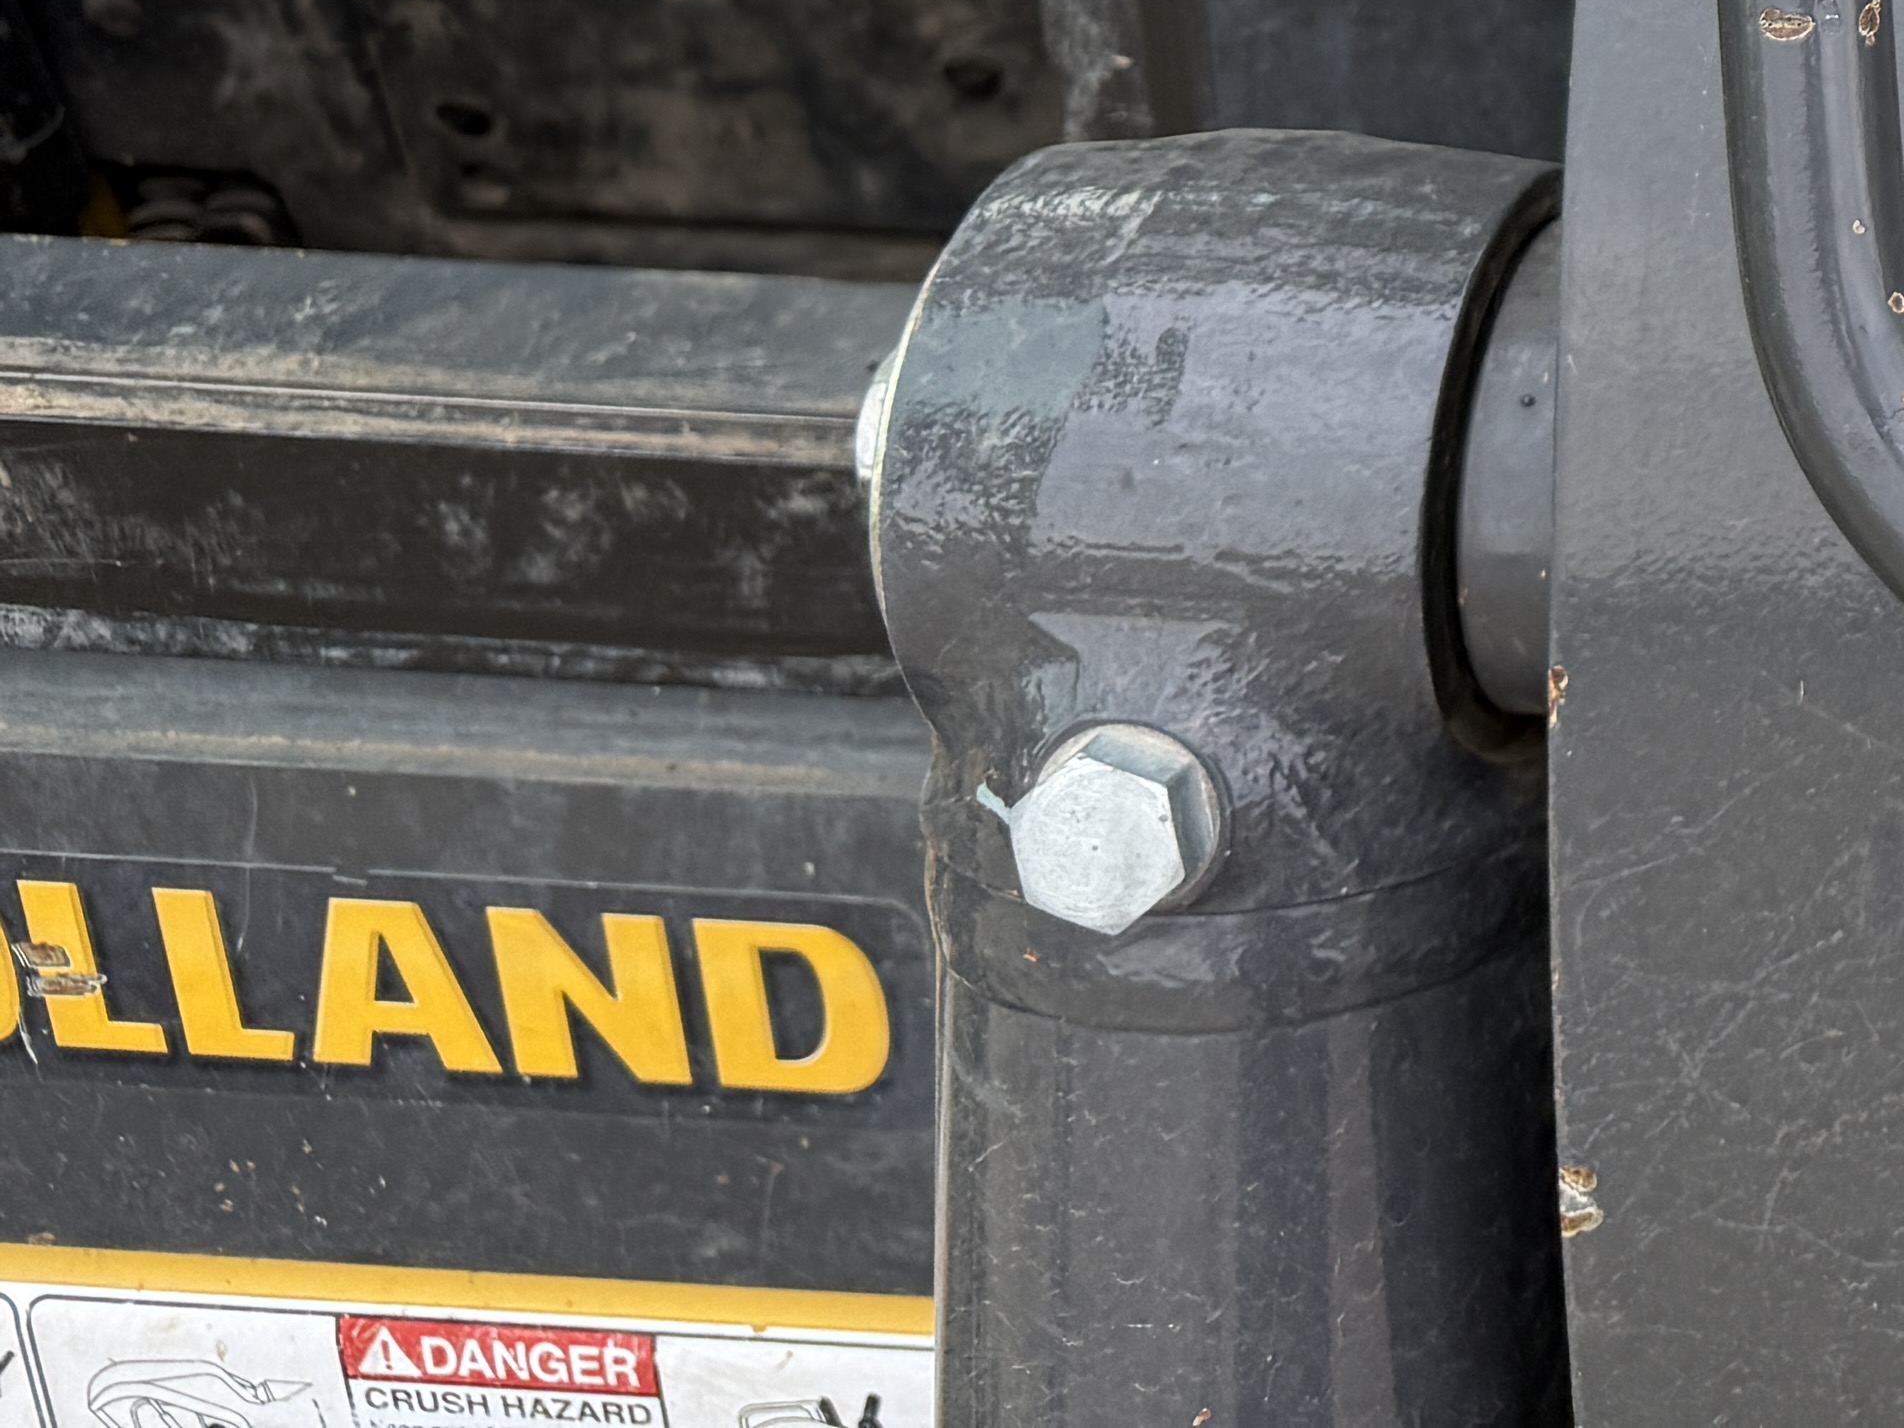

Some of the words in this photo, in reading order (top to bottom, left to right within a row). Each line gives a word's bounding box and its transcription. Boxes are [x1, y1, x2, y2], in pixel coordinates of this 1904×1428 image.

[0, 879, 891, 1094] LLAND
[420, 1336, 641, 1388] DANGER
[365, 1387, 490, 1417] CRUSH
[502, 1395, 651, 1425] HAZARD
